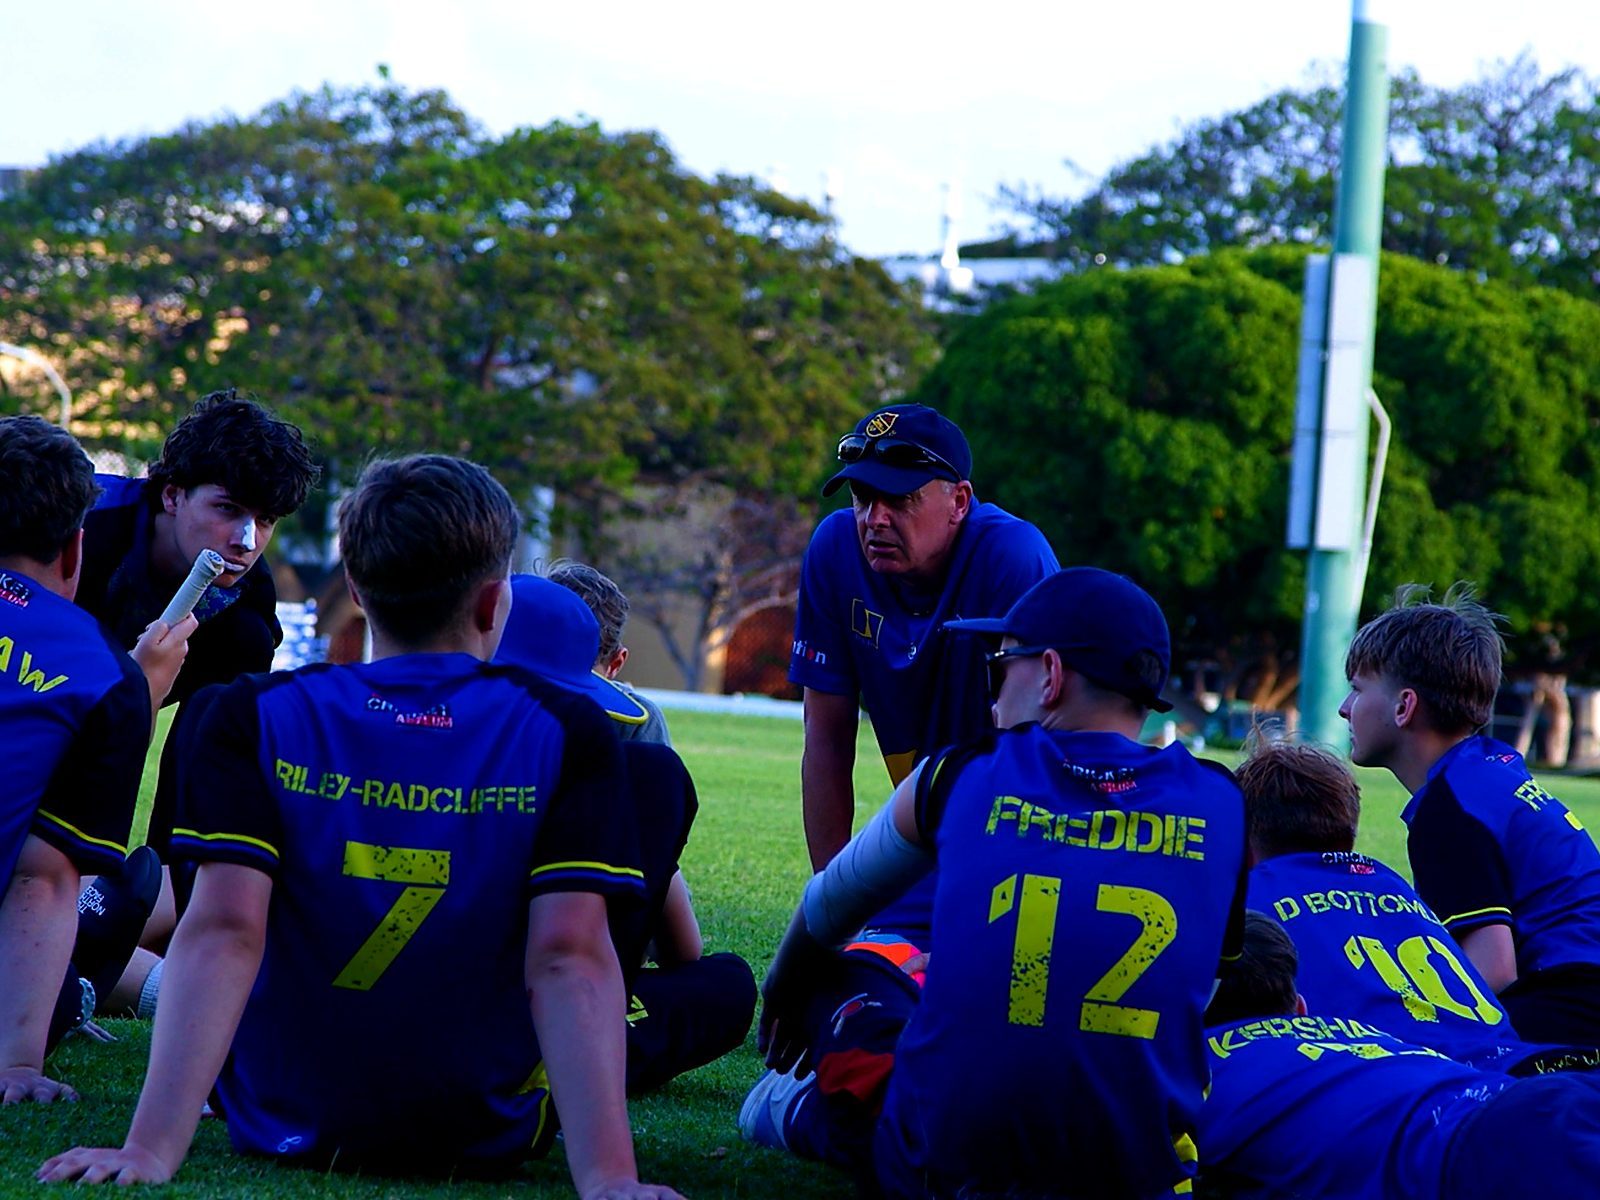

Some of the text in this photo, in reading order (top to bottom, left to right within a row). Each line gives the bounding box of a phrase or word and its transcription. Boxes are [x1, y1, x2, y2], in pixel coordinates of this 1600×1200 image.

[792, 639, 826, 665] tion
[276, 758, 536, 814] RILEY-RADCLIFFE
[985, 795, 1206, 861] FREDDIE
[332, 840, 451, 991] 7
[1273, 896, 1300, 922] D
[988, 873, 1178, 1039] 12
[1344, 935, 1503, 1026] 10
[1208, 1017, 1404, 1059] KERSHA
